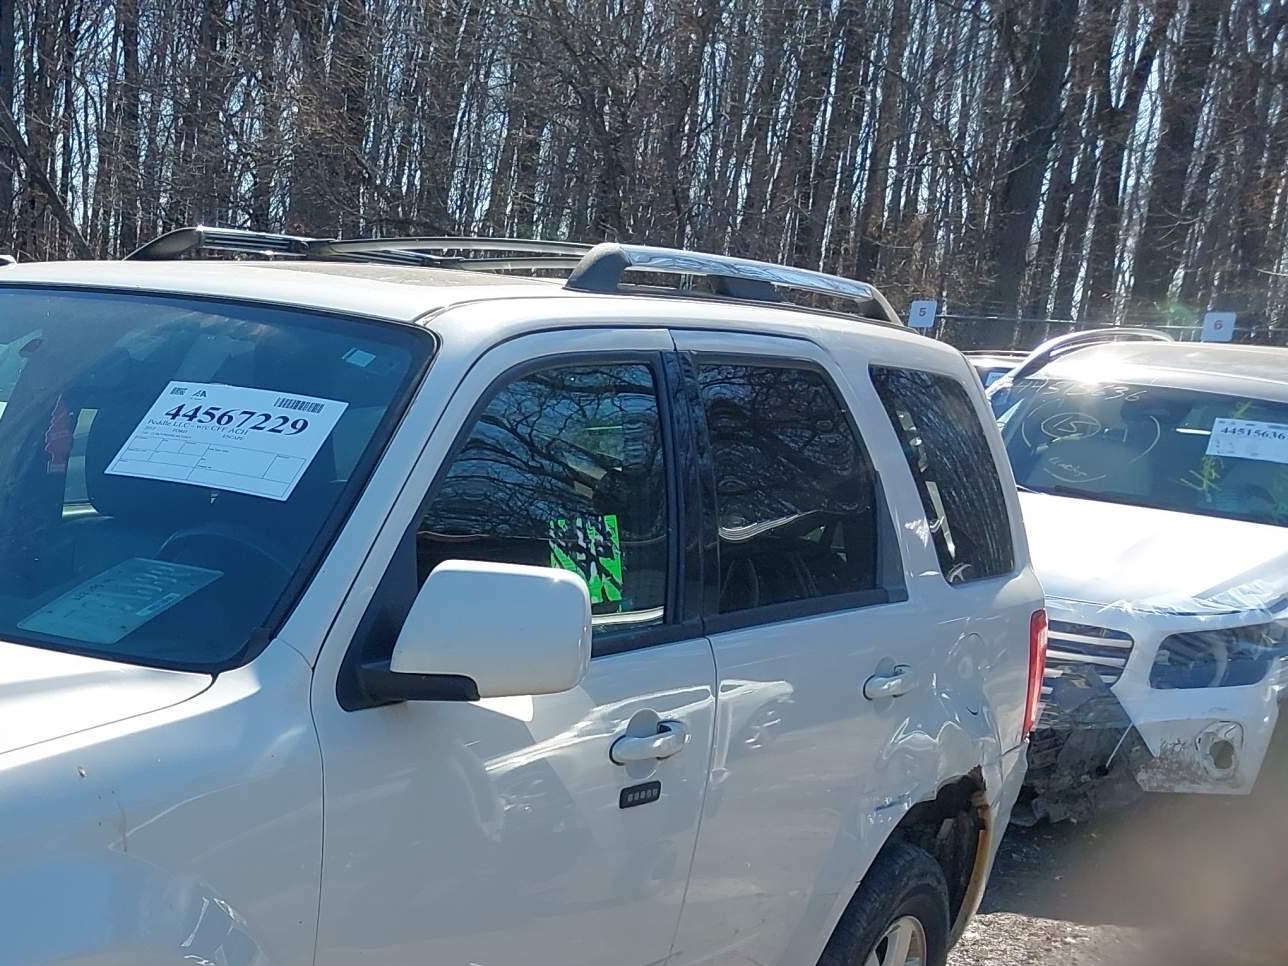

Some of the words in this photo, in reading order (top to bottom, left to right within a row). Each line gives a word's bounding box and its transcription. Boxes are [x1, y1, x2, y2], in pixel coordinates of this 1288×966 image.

[919, 307, 928, 317] 5
[1214, 319, 1224, 330] 6
[165, 403, 309, 436] 44567229
